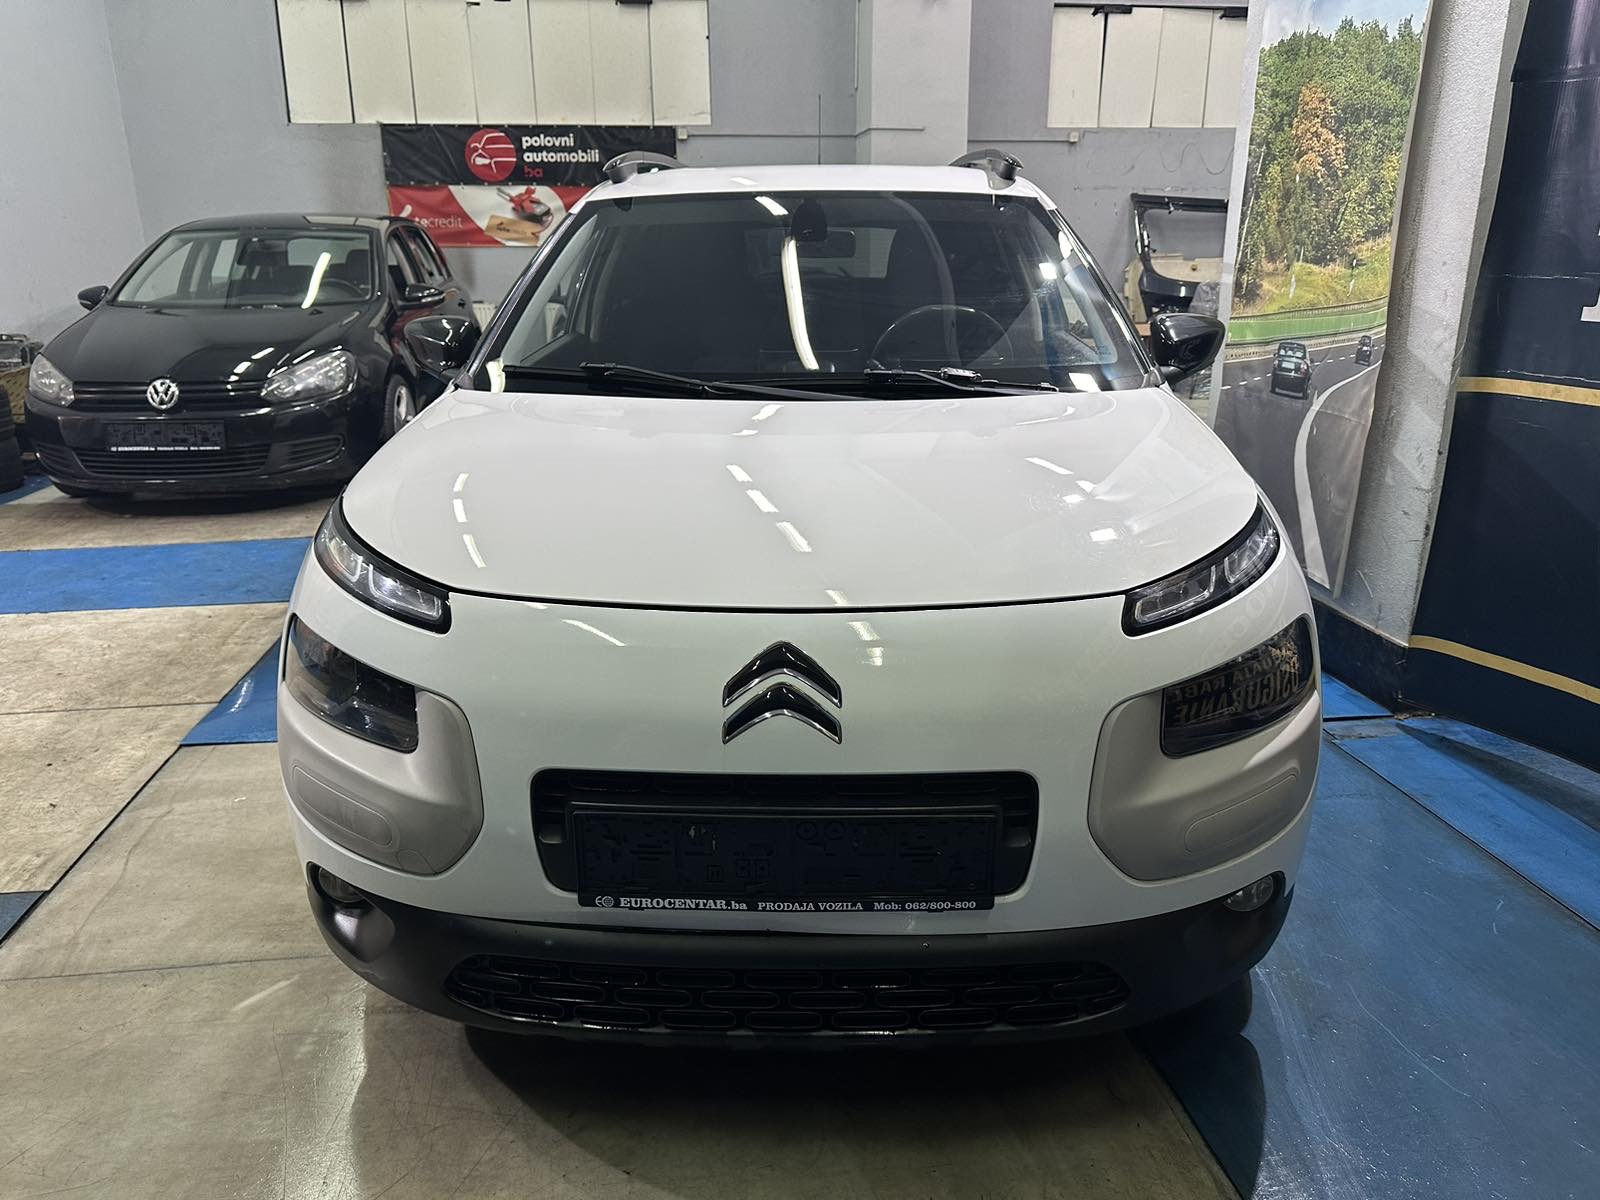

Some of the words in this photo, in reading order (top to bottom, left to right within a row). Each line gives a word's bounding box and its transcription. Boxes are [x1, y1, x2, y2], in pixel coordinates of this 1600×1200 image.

[521, 133, 575, 149] polovni
[522, 149, 600, 162] automobili
[618, 897, 748, 911] EUROCENTAR.ba
[757, 902, 815, 911] PRODAJA
[817, 902, 864, 911] VOZILA
[873, 902, 902, 911] Mob:
